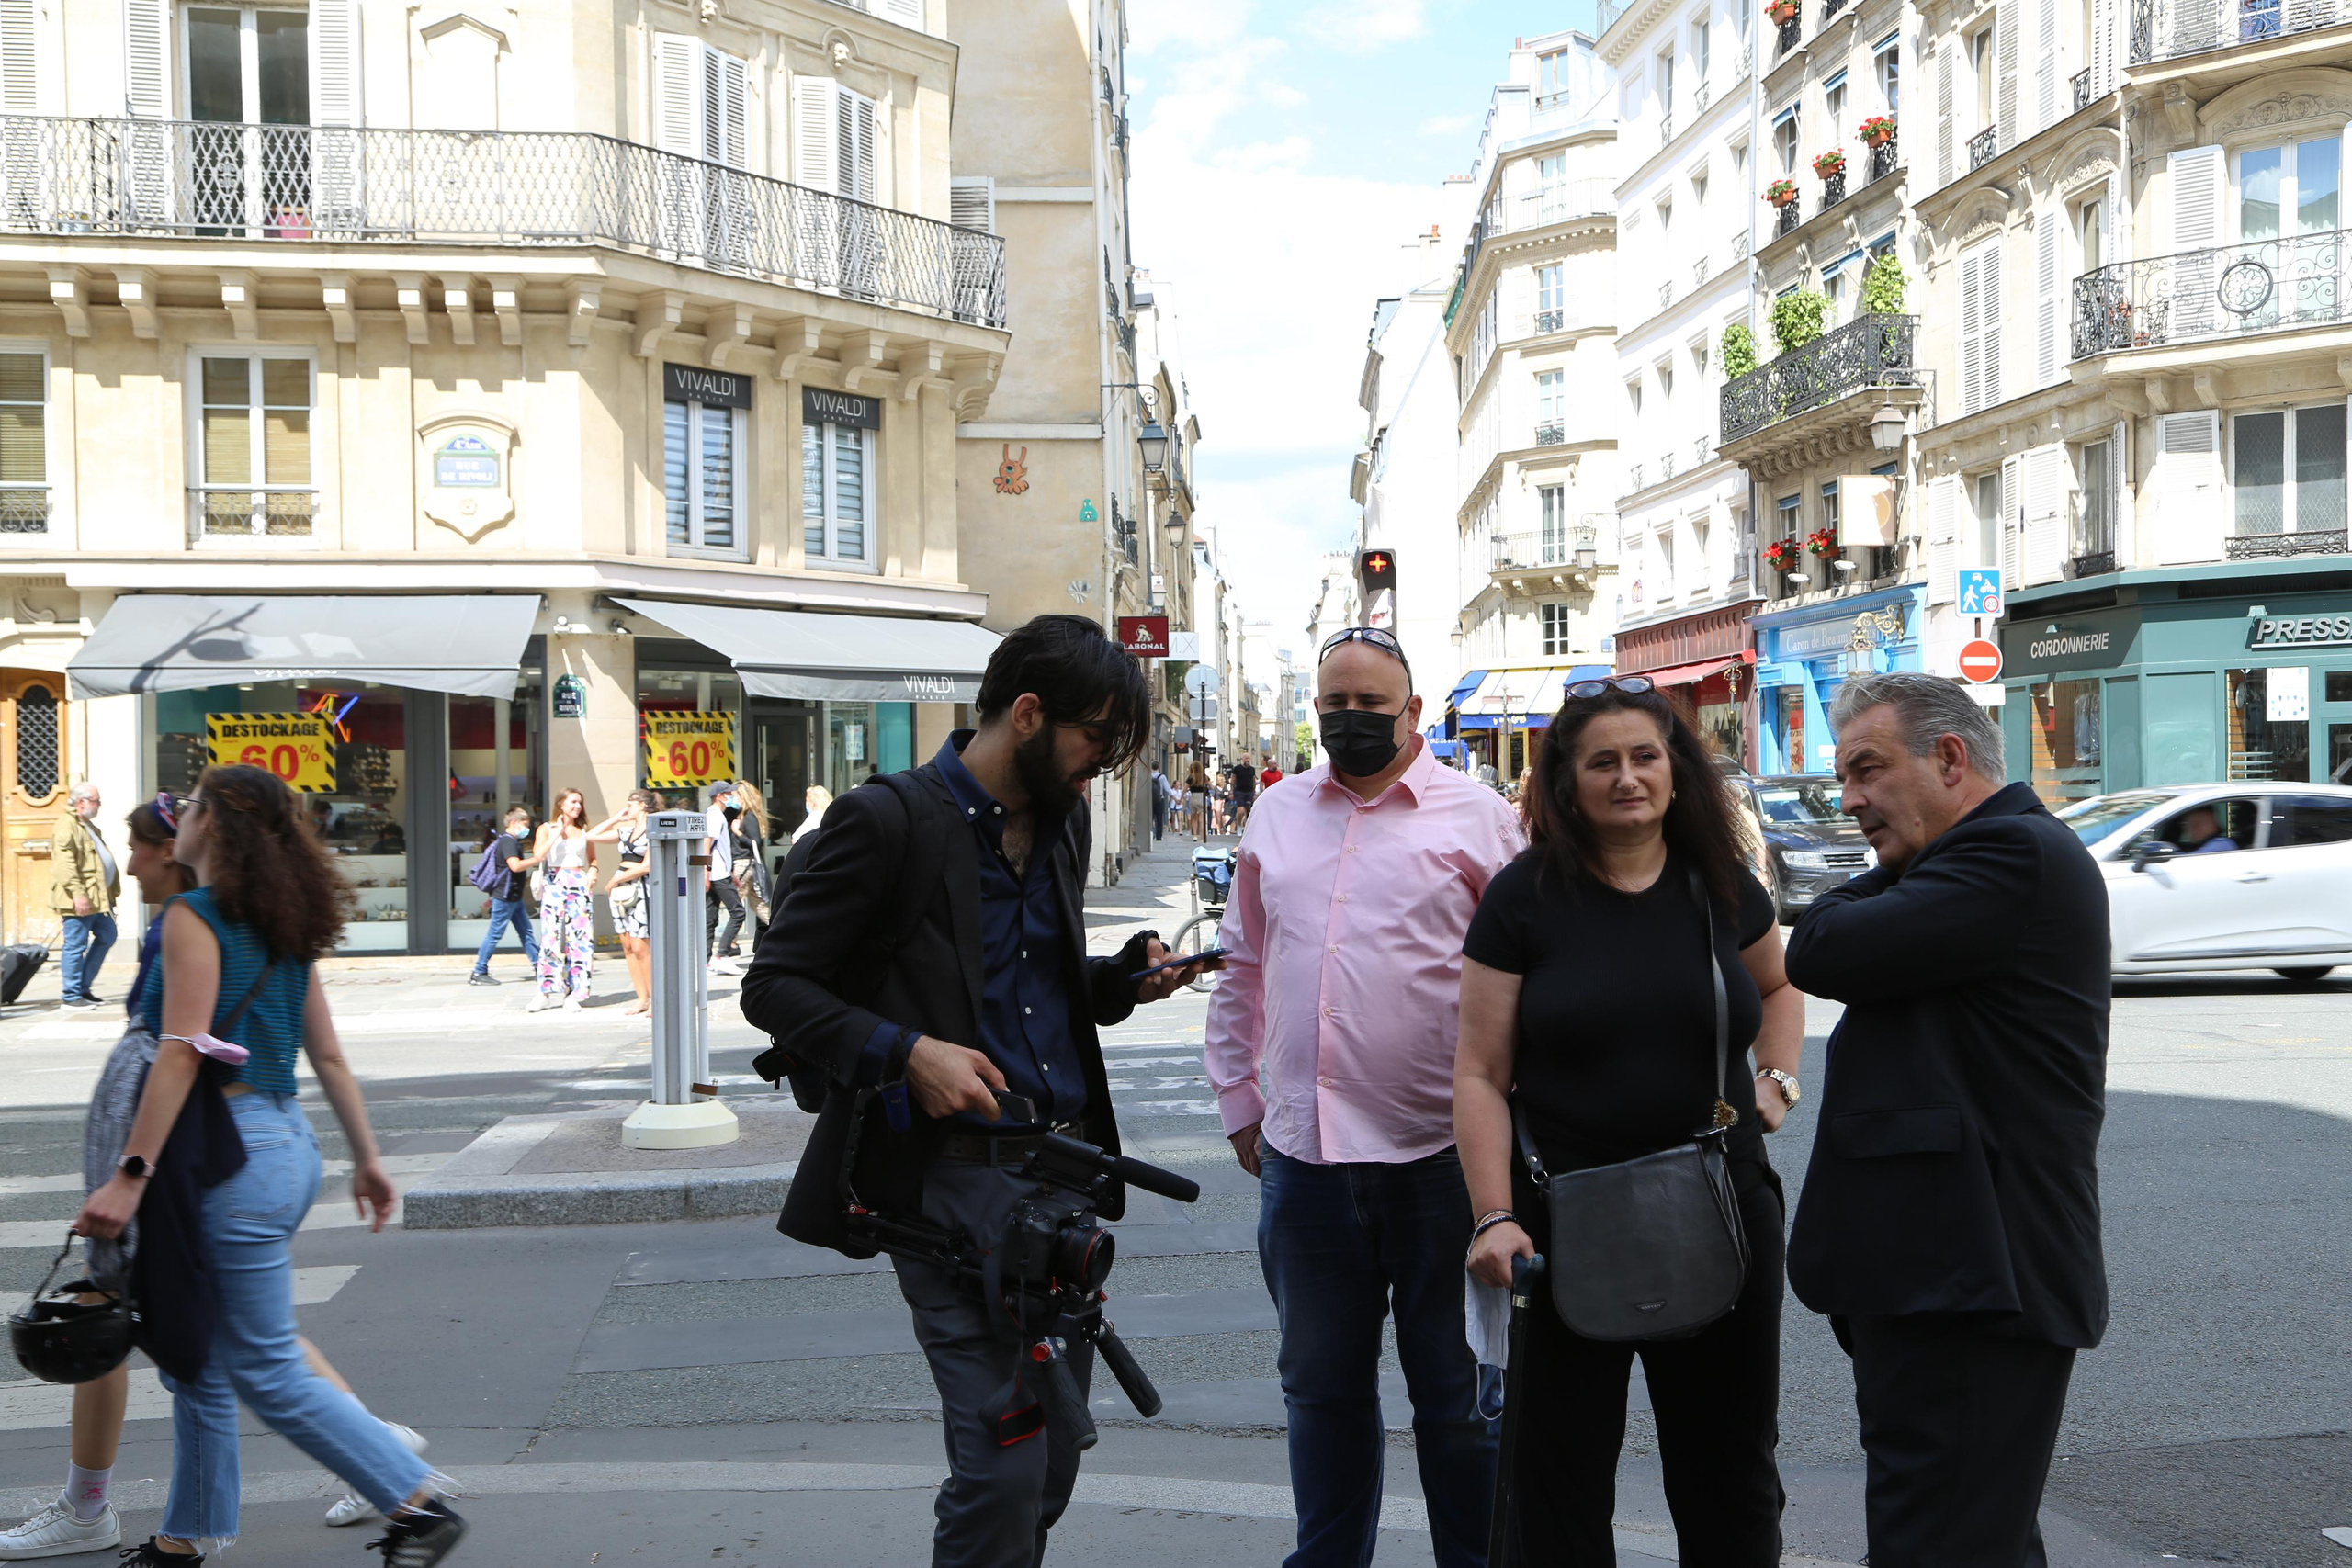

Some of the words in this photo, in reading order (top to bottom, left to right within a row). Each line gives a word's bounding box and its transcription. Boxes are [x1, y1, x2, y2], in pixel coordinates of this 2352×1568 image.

[675, 368, 736, 397] VIVALDI
[811, 391, 866, 419] VIVALDI
[441, 471, 457, 480] DE
[459, 472, 493, 480] RIVOLI
[456, 461, 480, 470] RUE
[2256, 616, 2352, 640] PRESS
[1786, 634, 1809, 652] Caron
[1811, 630, 1819, 649] de
[2030, 632, 2109, 659] CORDONNERIE
[903, 675, 955, 694] VIVALDI
[221, 723, 319, 738] DESTOCKAGE
[655, 722, 724, 734] DESTOCKAGE
